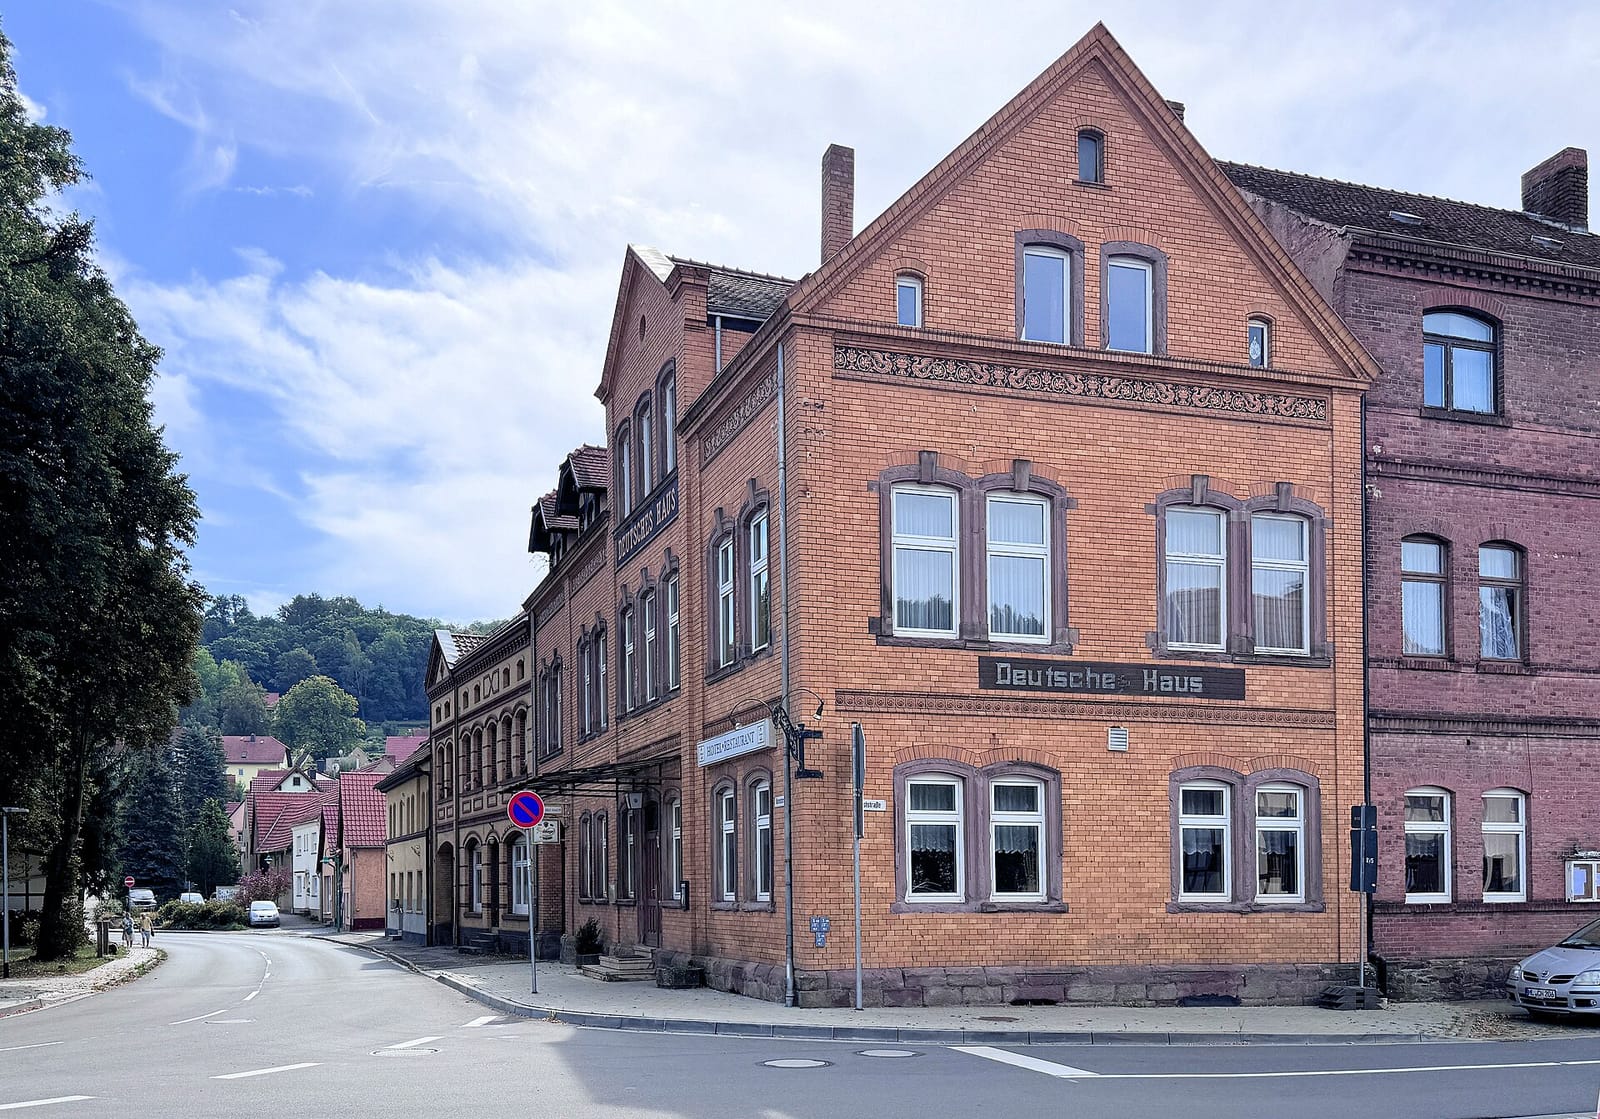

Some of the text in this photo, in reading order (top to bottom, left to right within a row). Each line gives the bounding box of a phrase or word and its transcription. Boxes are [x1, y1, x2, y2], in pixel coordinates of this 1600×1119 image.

[618, 487, 676, 560] DEUTSCHES HAUS
[1143, 669, 1203, 692] Haus
